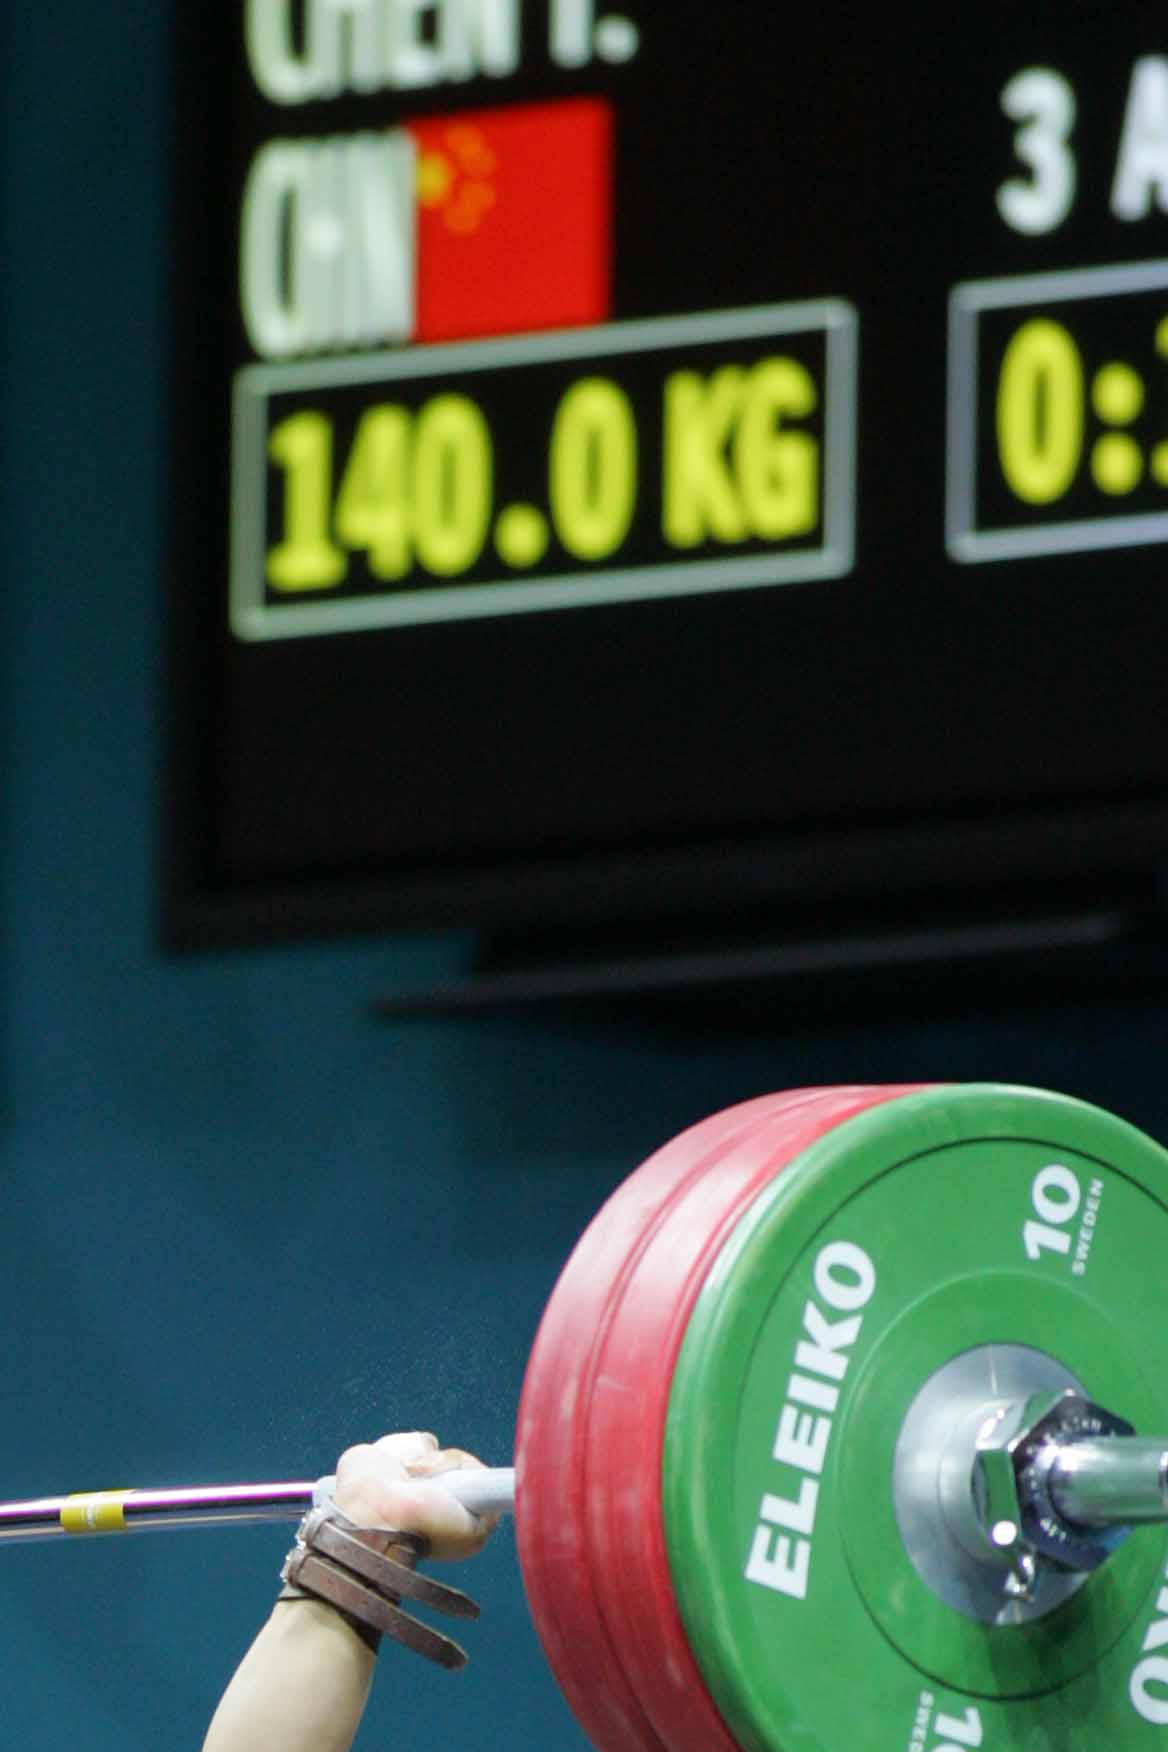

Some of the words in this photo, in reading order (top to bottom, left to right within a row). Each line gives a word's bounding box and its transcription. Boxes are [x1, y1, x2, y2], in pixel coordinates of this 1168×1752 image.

[996, 66, 1076, 236] 3
[264, 378, 636, 592] 140.0
[664, 356, 818, 548] KG
[1023, 1163, 1081, 1260] 10
[1072, 1178, 1103, 1276] SWEDEN
[744, 1240, 876, 1600] ELEIKO
